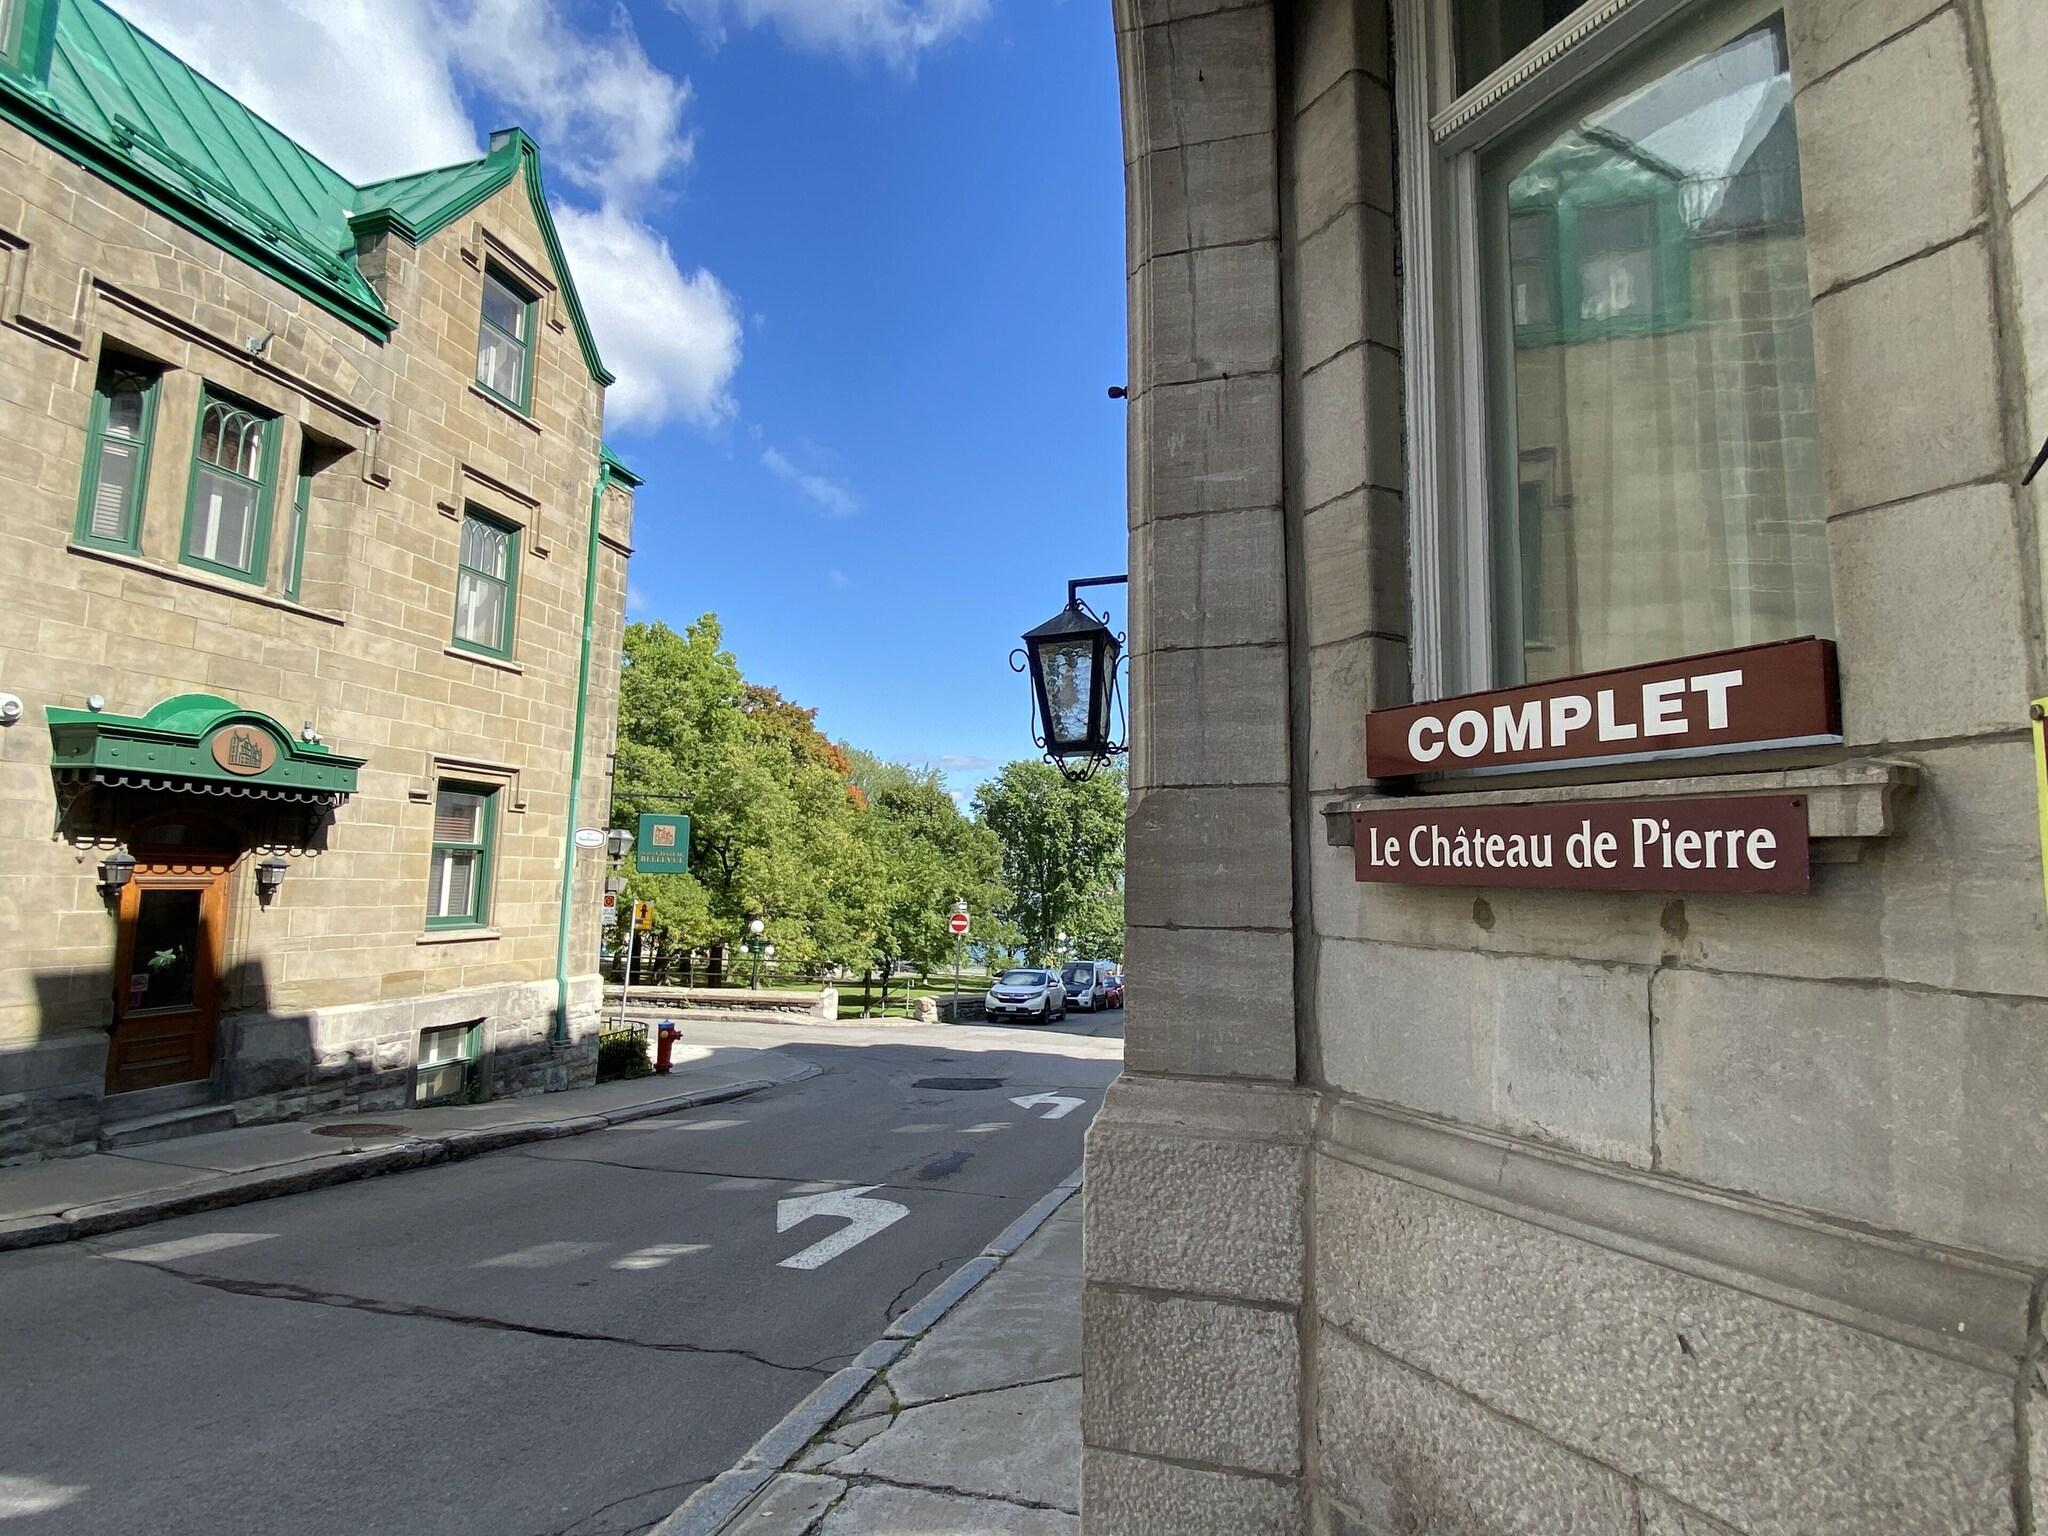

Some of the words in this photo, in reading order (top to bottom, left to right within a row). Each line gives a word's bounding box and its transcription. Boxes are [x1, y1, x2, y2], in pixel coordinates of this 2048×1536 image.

[1407, 669, 1743, 763] COMPLET
[1369, 826, 1401, 867] Le
[1408, 824, 1553, 868] Château
[1565, 819, 1618, 869] de
[1632, 817, 1777, 870] Pierre
